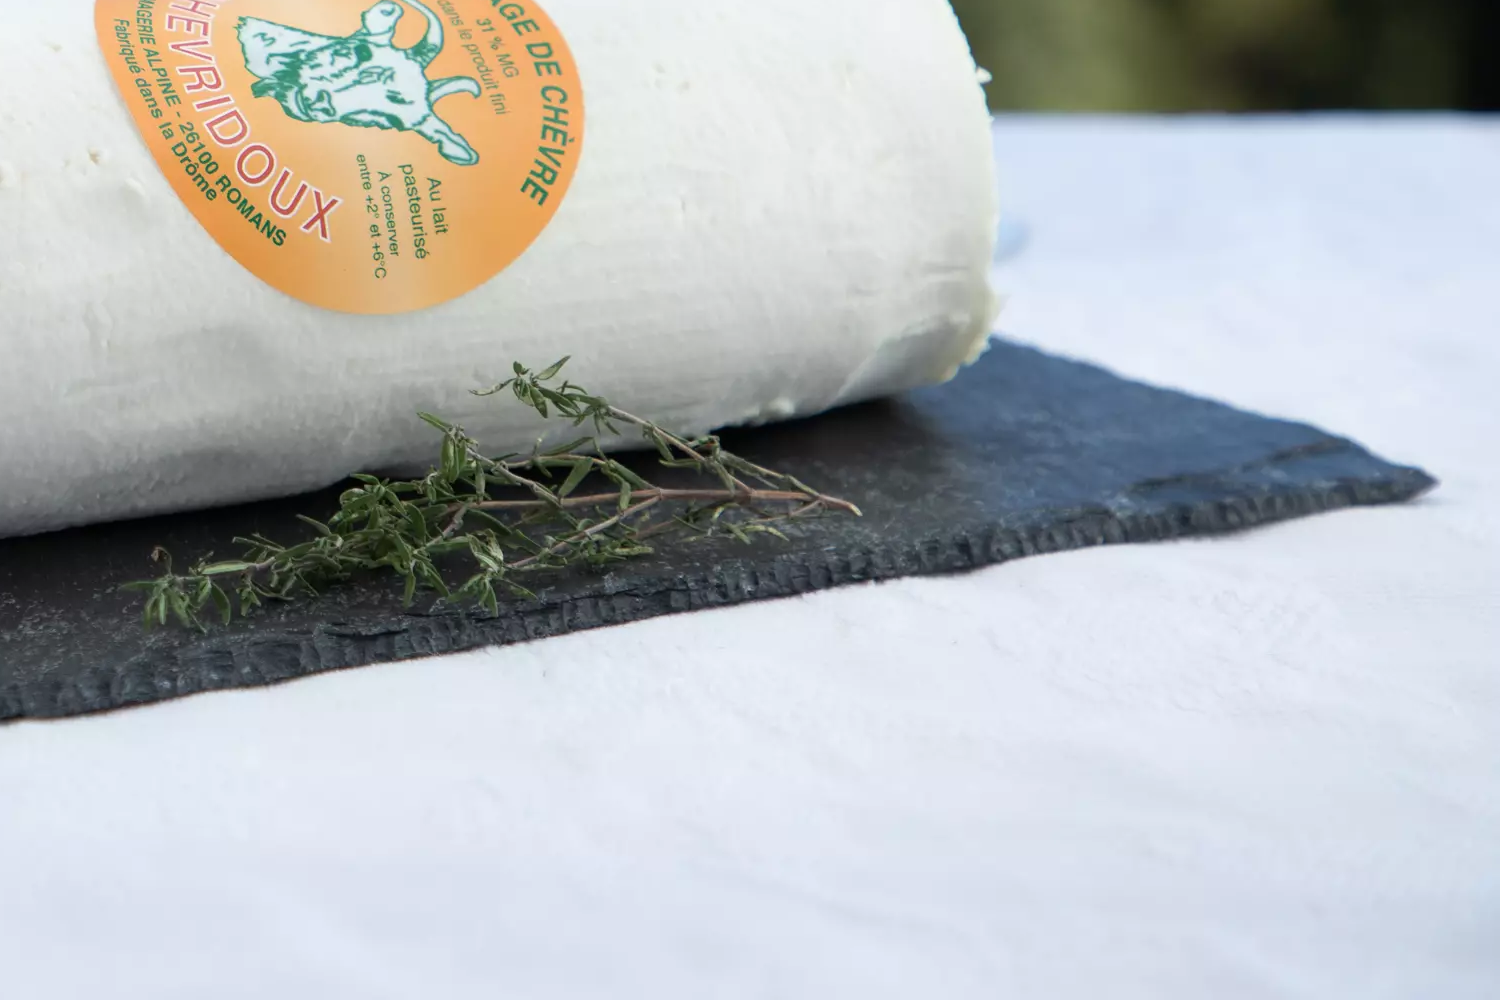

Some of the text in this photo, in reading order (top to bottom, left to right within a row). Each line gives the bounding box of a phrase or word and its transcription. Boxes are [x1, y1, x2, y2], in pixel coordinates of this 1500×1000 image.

[437, 0, 511, 116] dans le produit fini
[476, 18, 520, 79] 31 % MG
[525, 42, 562, 77] DE
[113, 18, 218, 201] Fabriqué dans la Drôme
[143, 47, 182, 107] ALPINE
[179, 121, 219, 175] 26100
[215, 175, 287, 247] ROMANS
[520, 85, 575, 207] CHÈVRE
[356, 154, 372, 191] entre
[369, 224, 382, 238] et
[380, 185, 399, 257] conserver
[397, 164, 431, 259] pasteurisé
[426, 177, 449, 235] Au lait
